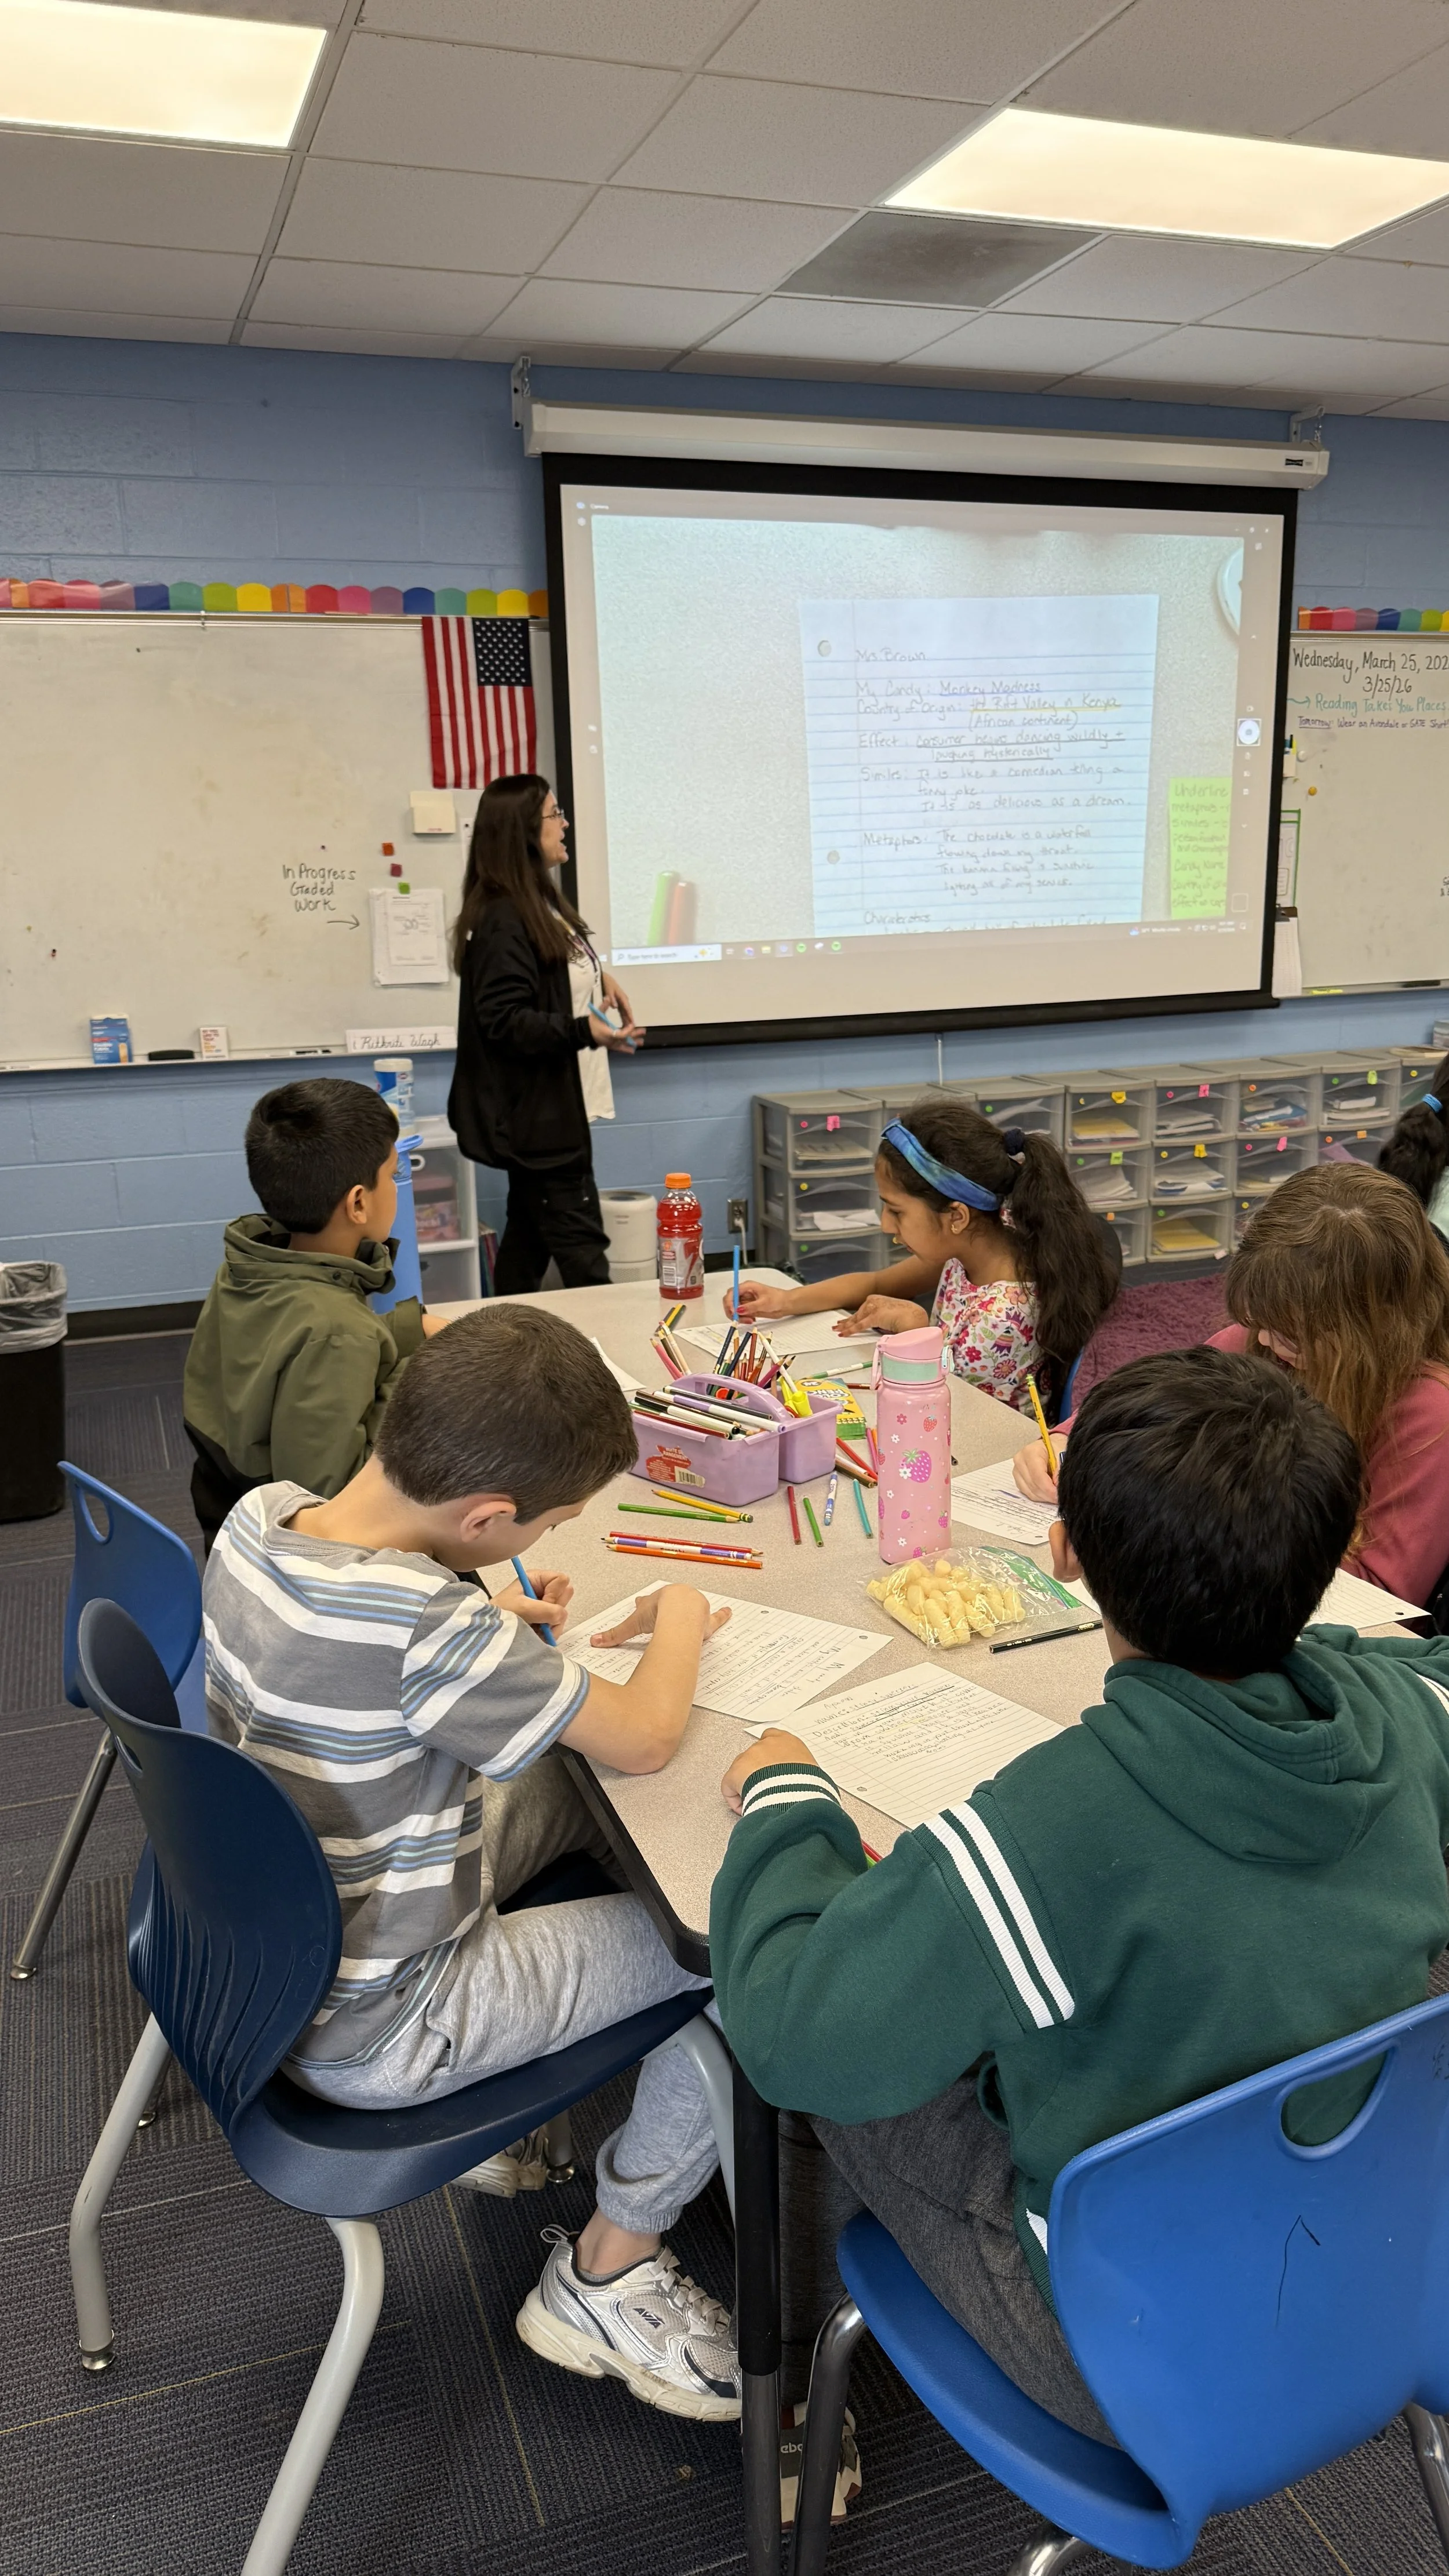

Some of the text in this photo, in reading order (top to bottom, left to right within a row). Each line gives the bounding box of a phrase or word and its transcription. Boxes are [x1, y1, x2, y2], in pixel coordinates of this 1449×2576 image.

[880, 647, 927, 662] Brown
[1293, 647, 1449, 684] Wednesday, March 25, 202
[855, 680, 879, 706] My
[940, 680, 985, 705] Monkey
[991, 680, 1041, 693] Madness
[1363, 674, 1412, 701] 3/25/26
[857, 698, 901, 722] Country
[992, 695, 1018, 710] Rift
[1022, 696, 1058, 717] Valley
[1082, 692, 1123, 712] Kenya
[1316, 693, 1358, 718] Reading
[1363, 698, 1393, 712] Takes
[1396, 698, 1415, 714] You
[1022, 710, 1079, 731] continent)
[1337, 716, 1356, 728] Wear
[1015, 730, 1062, 752] dancing
[1068, 729, 1109, 749] wildly
[984, 746, 1051, 761] hysterically
[938, 769, 949, 779] is
[961, 767, 984, 779] like
[1007, 766, 1064, 778] comedian
[1175, 783, 1229, 798] Underline
[993, 794, 1043, 809] delicious
[1051, 796, 1066, 806] as
[1072, 799, 1081, 807] a
[936, 828, 957, 842] The
[936, 844, 981, 864] flowing
[282, 863, 356, 885] In Progress
[935, 863, 955, 875] The
[290, 881, 335, 896] Graded
[294, 898, 337, 912] Work
[632, 2308, 665, 2329] AVIA
